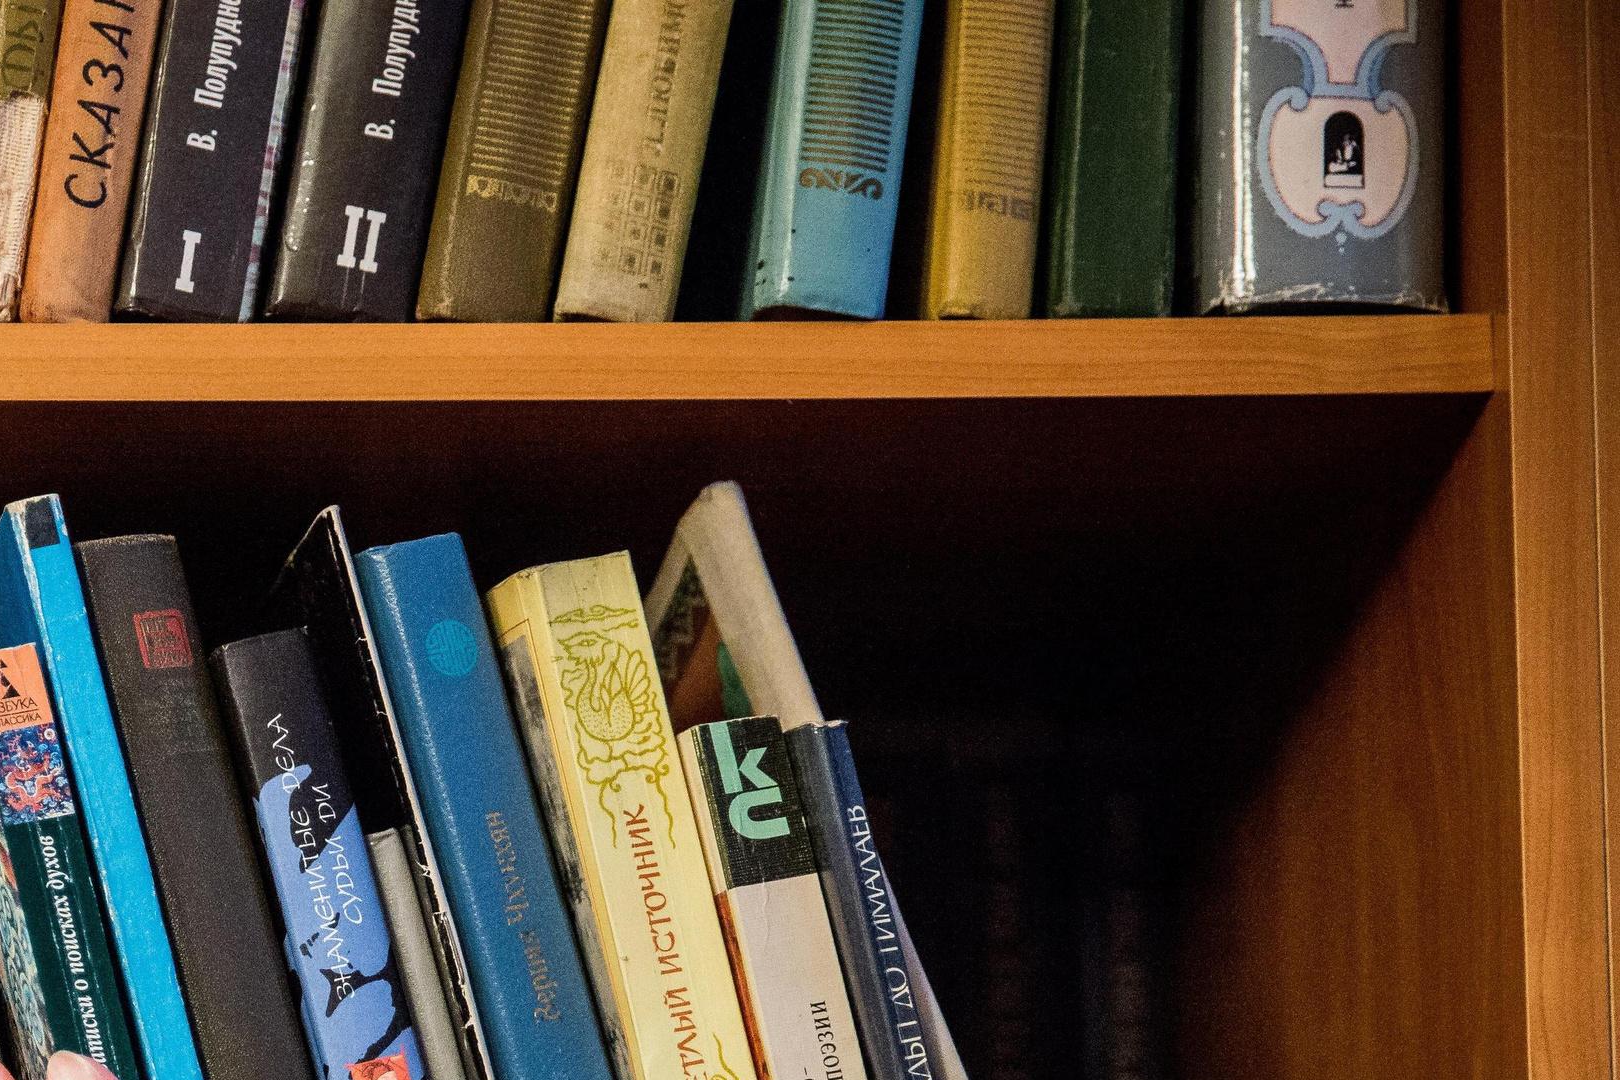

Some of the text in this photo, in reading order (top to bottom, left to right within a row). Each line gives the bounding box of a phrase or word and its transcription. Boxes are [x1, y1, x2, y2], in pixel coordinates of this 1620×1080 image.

[64, 0, 136, 209] СКАЗА
[185, 129, 218, 151] В.
[363, 119, 395, 140] В.
[336, 205, 387, 274] II
[266, 713, 356, 999] ЗНАМЕНИТЫЕ ДЕЛА
[313, 783, 363, 924] СУДЬИ ДИ
[623, 803, 681, 975] ИСТОЧНИК
[40, 834, 108, 1069] аписки о поисках духов
